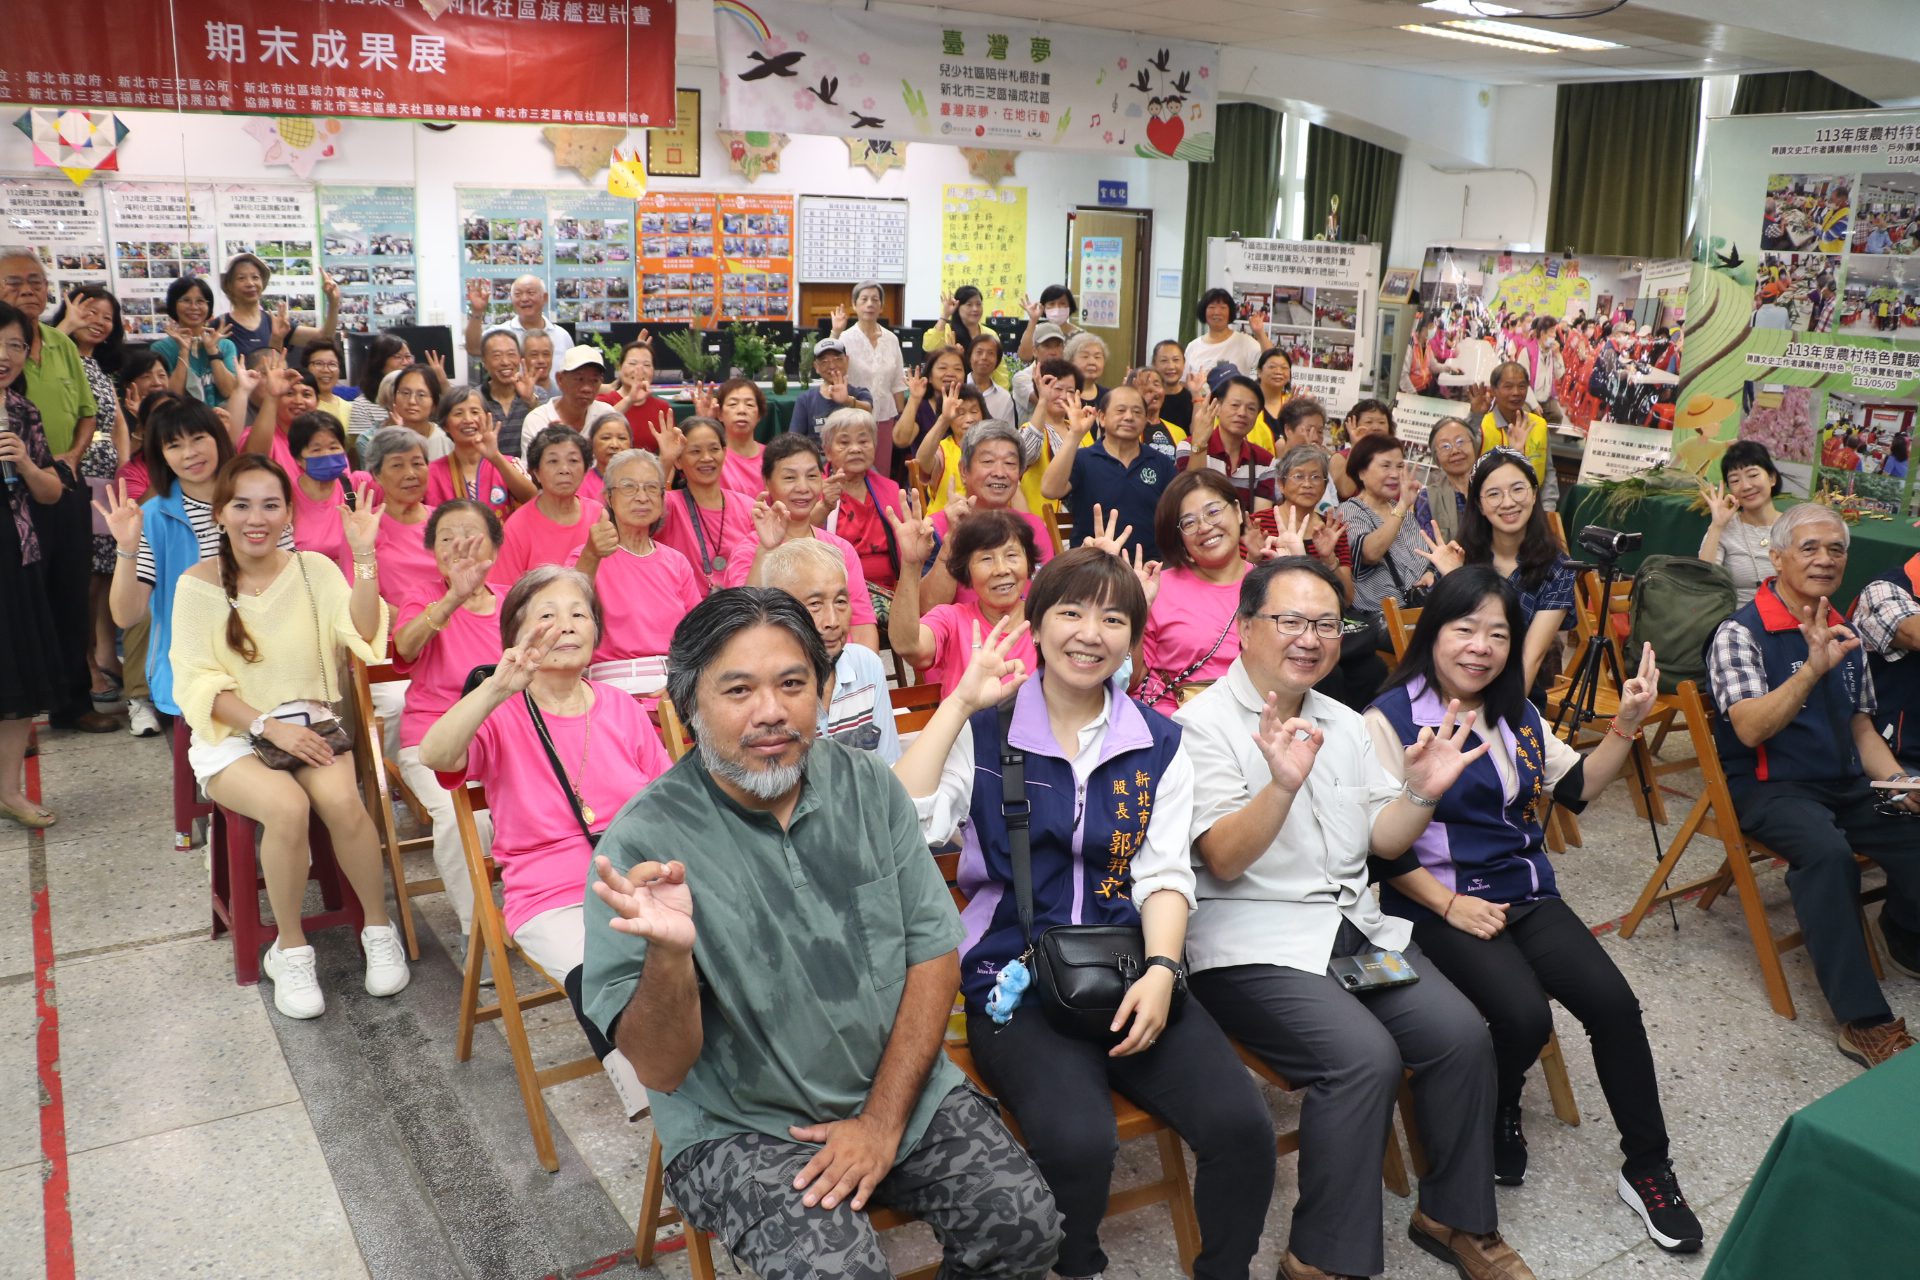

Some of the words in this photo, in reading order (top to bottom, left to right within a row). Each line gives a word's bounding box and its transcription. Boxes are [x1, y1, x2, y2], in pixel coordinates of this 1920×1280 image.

[205, 20, 447, 74] 期末成果展
[942, 30, 1051, 63] 臺灣夢
[940, 64, 1050, 86] 兒少社區陪伴札根計畫
[941, 82, 1050, 104] 新北市三芝區福成社區
[1853, 377, 1897, 389] 113/05/05
[1113, 780, 1130, 819] 股長
